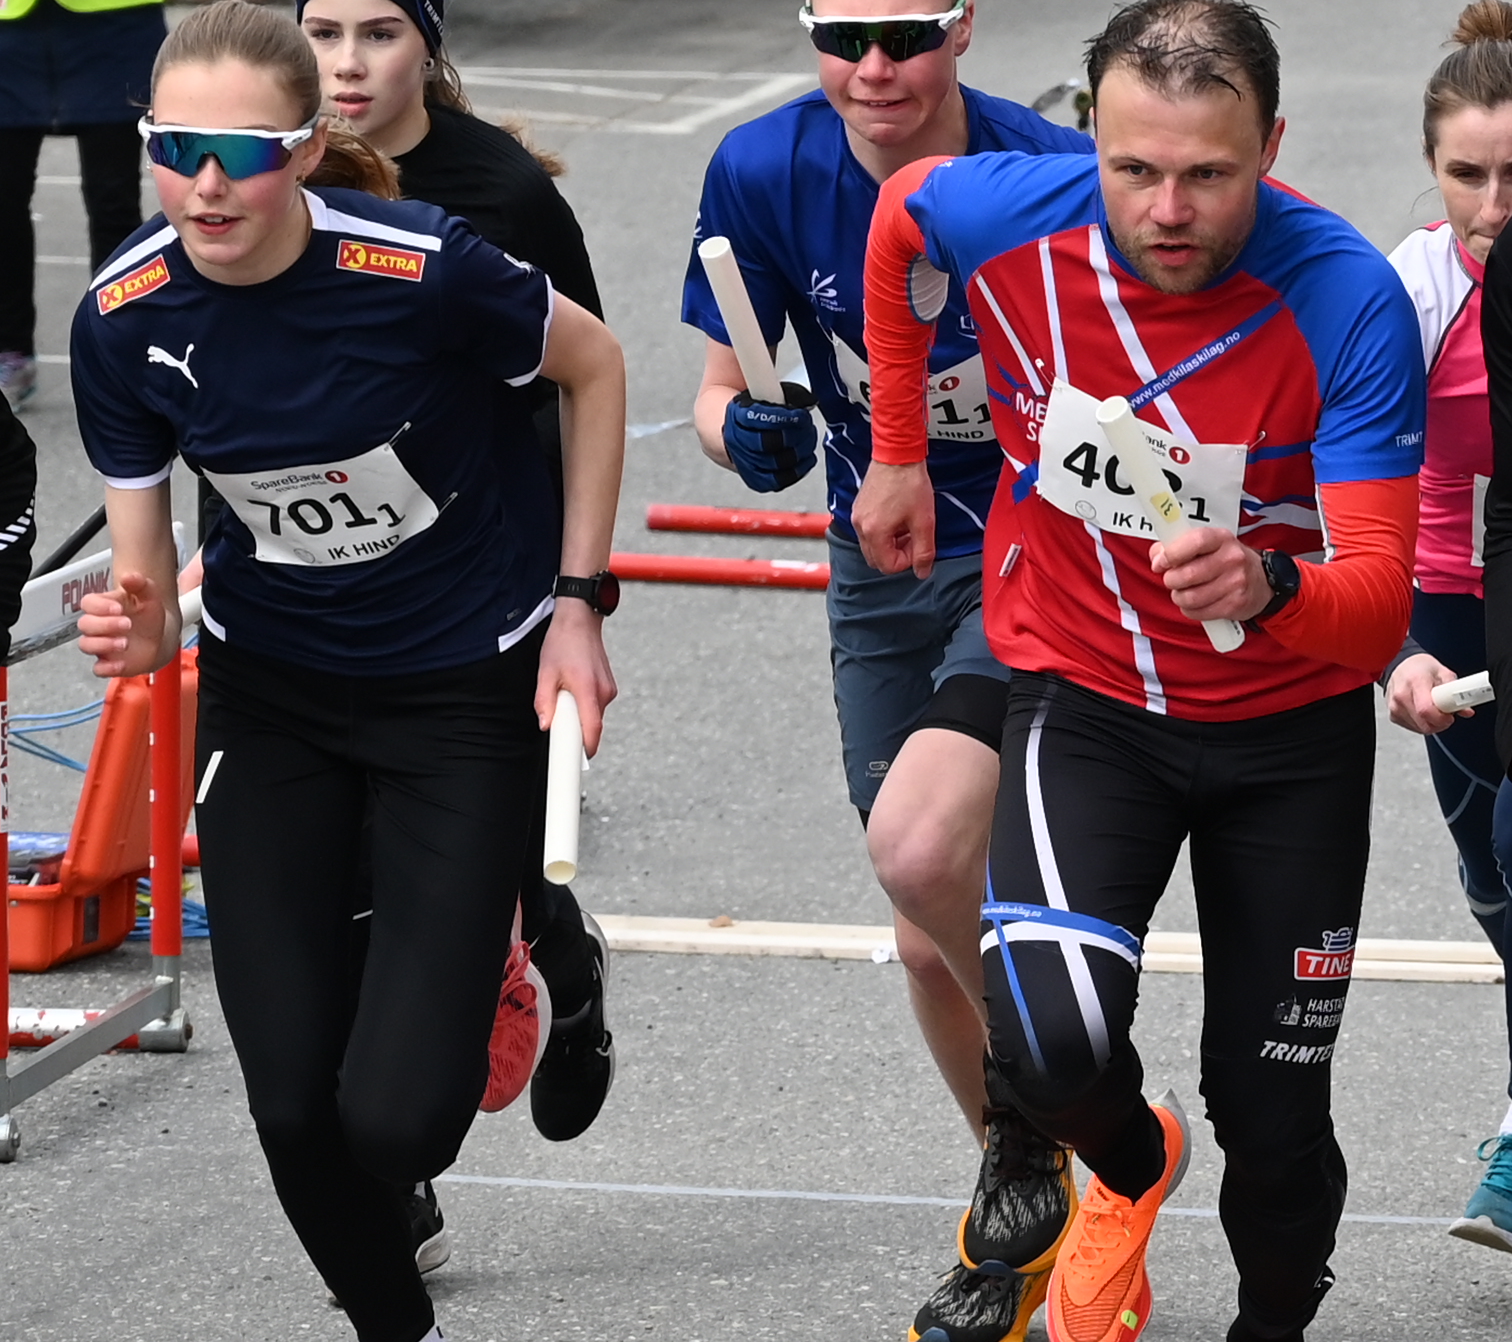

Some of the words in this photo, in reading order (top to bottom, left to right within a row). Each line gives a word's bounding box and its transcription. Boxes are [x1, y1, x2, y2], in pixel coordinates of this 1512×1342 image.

[369, 253, 419, 273] EXTRA
[124, 263, 166, 294] EXTRA
[945, 429, 985, 440] HIND
[250, 472, 323, 491] SpareBank
[1113, 512, 1134, 529] IK
[327, 545, 351, 561] IK
[353, 534, 401, 556] HIND
[1305, 955, 1352, 975] TINE
